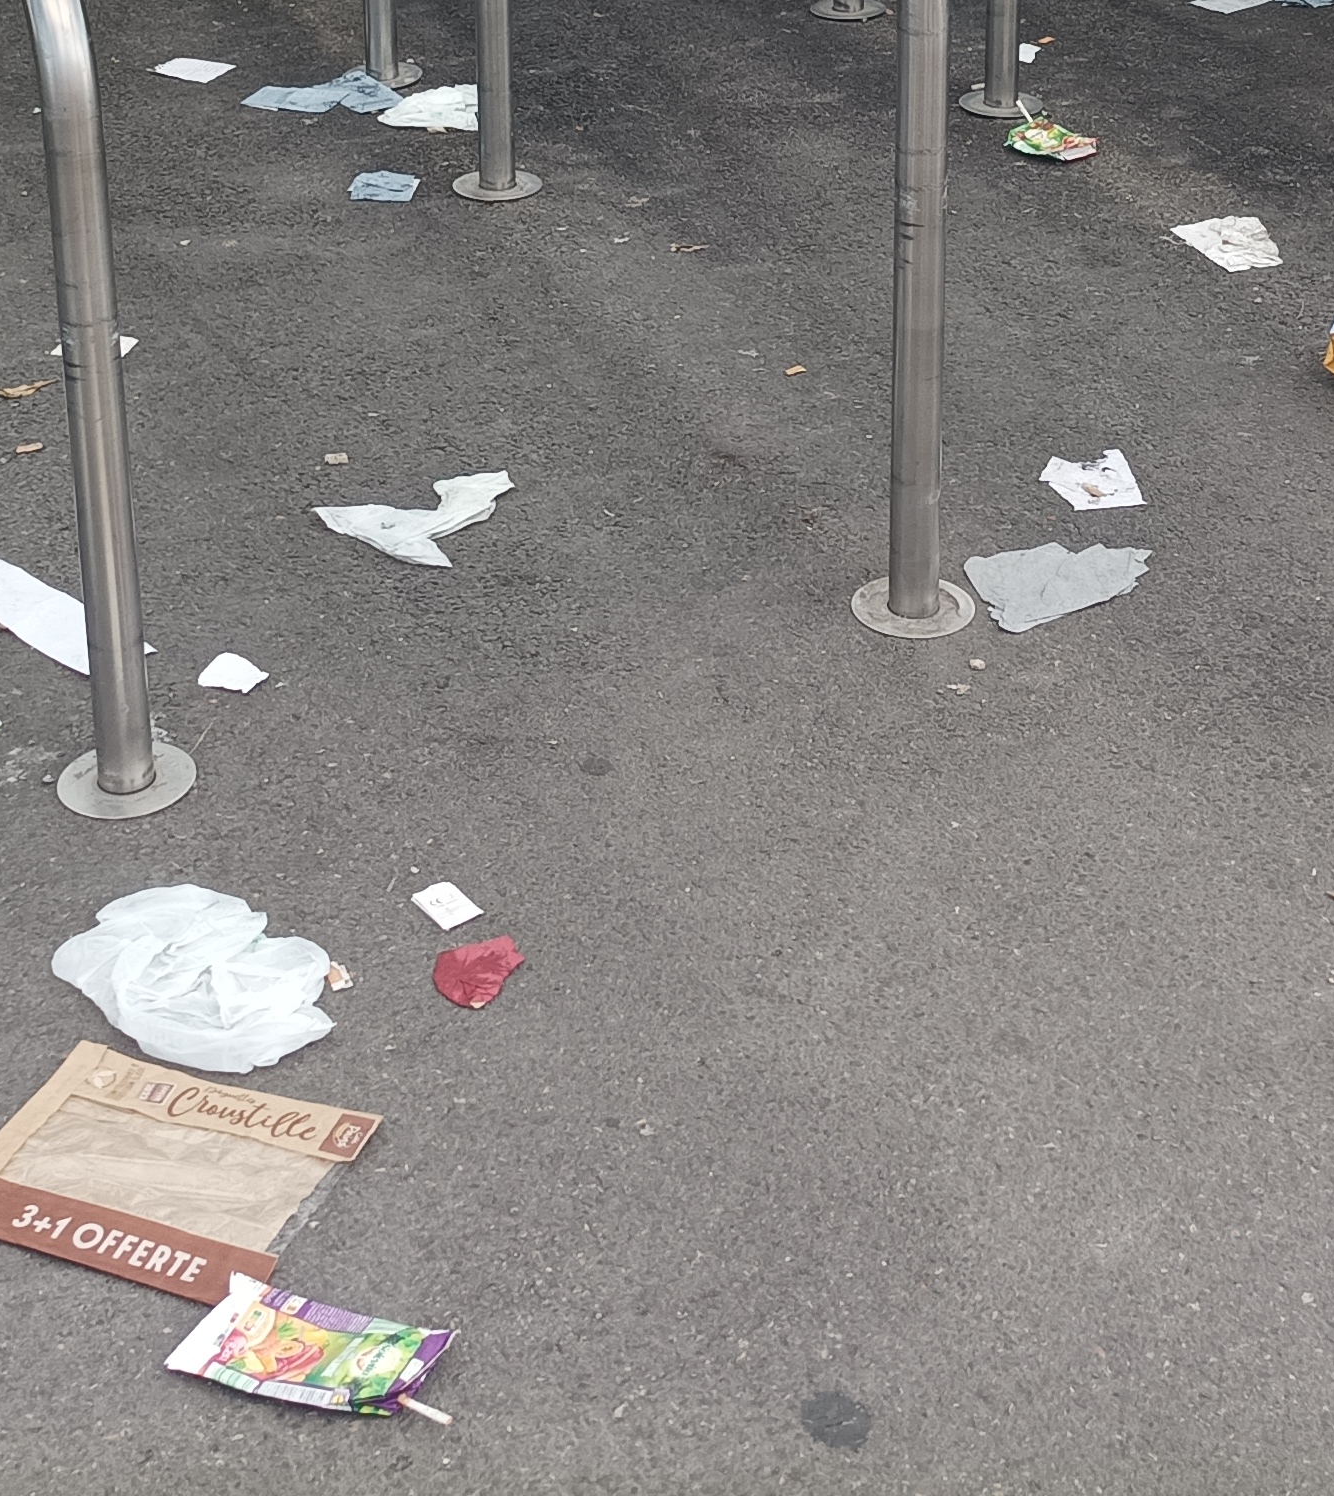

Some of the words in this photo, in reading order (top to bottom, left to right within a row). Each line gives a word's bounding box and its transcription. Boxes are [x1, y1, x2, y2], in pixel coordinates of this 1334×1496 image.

[167, 1086, 318, 1141] Croustille
[11, 1204, 73, 1240] 3+1
[72, 1222, 208, 1283] OFFERTE
